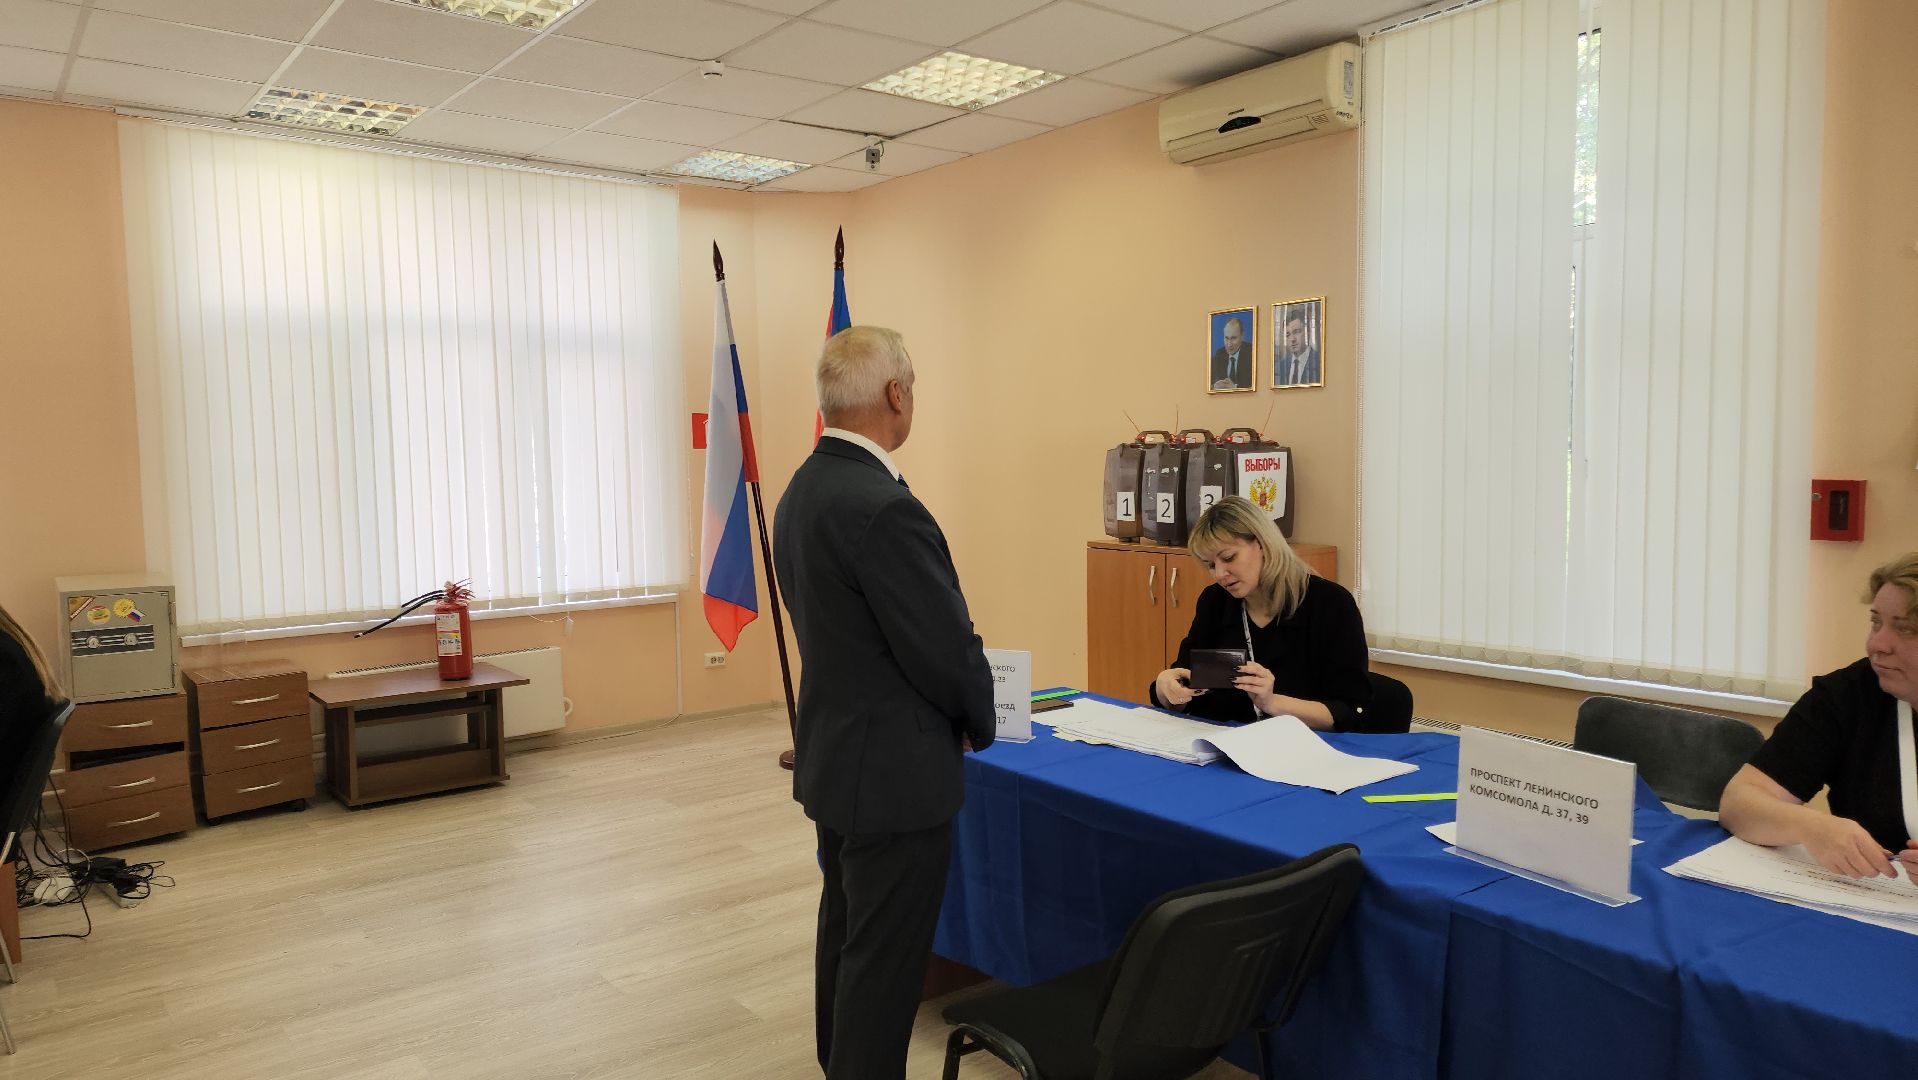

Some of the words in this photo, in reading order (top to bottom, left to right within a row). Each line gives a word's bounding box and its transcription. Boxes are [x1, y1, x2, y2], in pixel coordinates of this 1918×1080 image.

[1244, 458, 1281, 472] ВЫБОРЫ
[1122, 498, 1132, 516] 1
[1160, 498, 1171, 518] 2
[1204, 494, 1214, 506] 3
[1470, 767, 1522, 789] ПРОСПЕКТ
[1523, 782, 1599, 809] ЛЕНИНСКОГО
[1469, 784, 1539, 811] КОМСОМОЛА
[1541, 804, 1554, 816] Д.
[1555, 808, 1573, 822] 37,
[1575, 813, 1589, 825] 39
